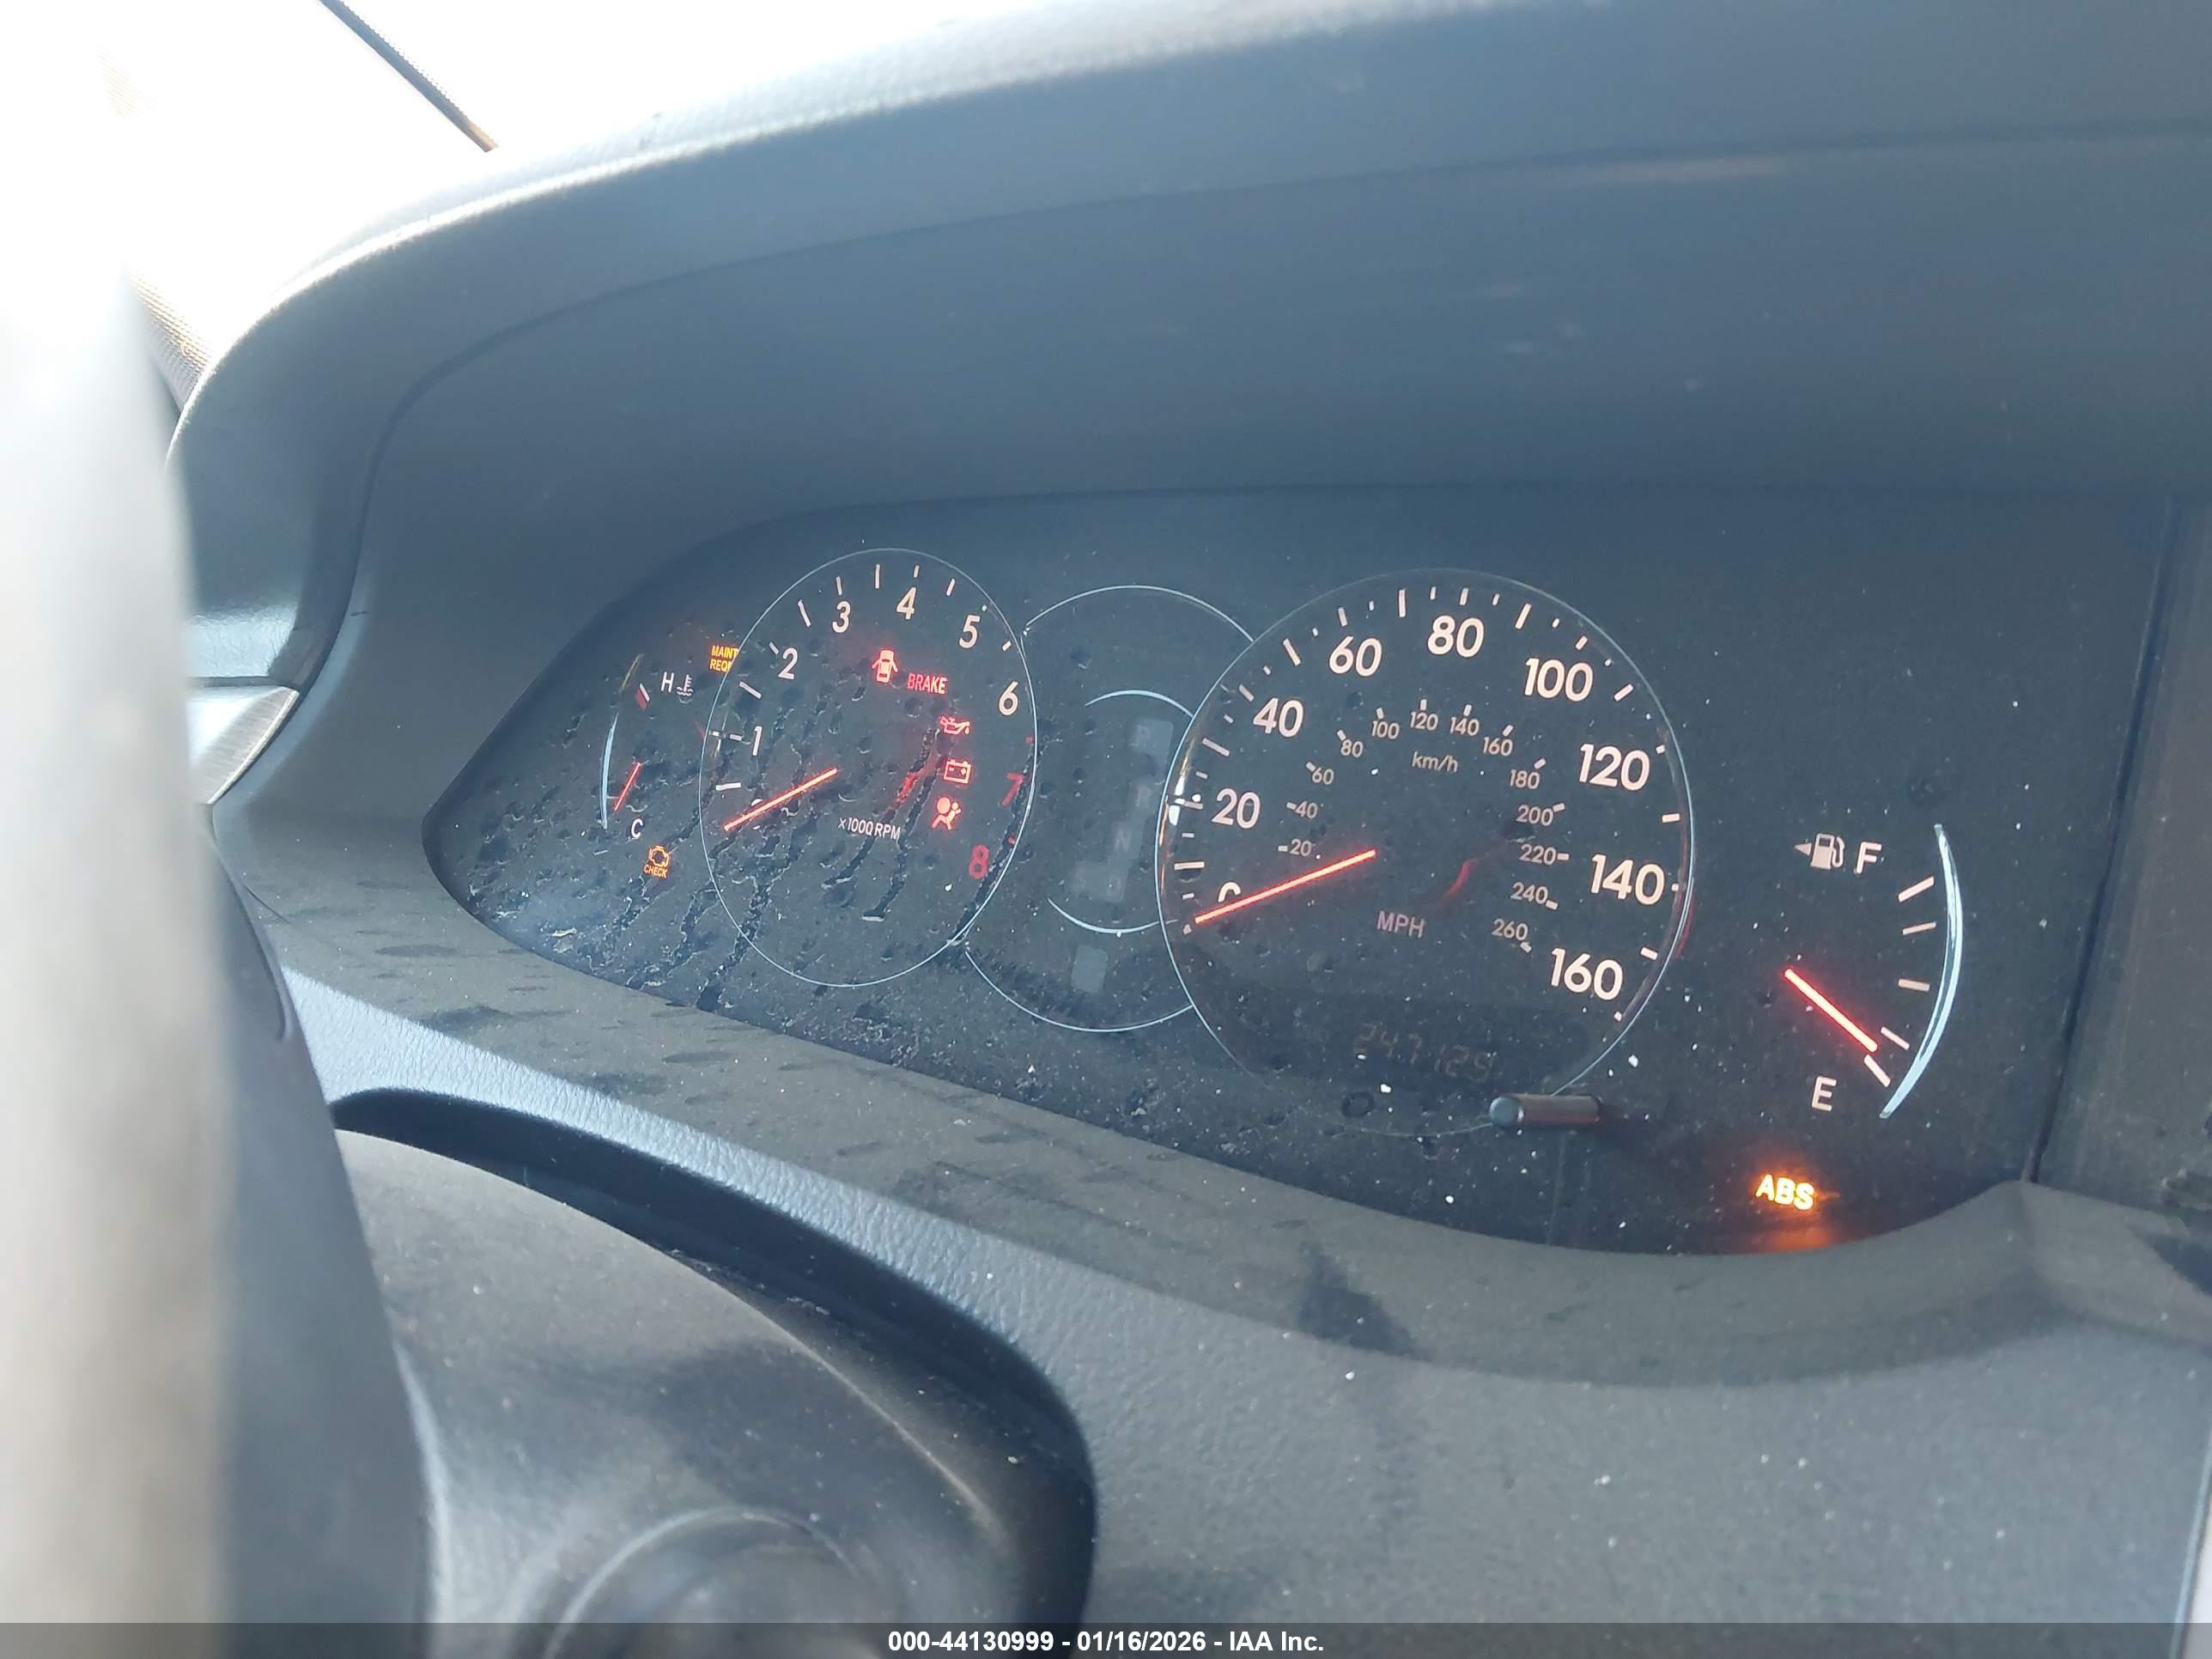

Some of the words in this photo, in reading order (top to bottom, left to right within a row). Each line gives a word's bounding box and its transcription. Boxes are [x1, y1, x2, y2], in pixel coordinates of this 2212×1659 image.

[832, 601, 851, 633] 3
[896, 587, 918, 619] 4
[959, 615, 981, 648] 5
[1427, 615, 1485, 658] 80
[711, 645, 739, 659] MAINT
[778, 647, 799, 679] 2
[1328, 635, 1383, 677] 60
[660, 672, 674, 693] H
[907, 672, 948, 696] BRAKE
[1523, 658, 1594, 702] 100
[998, 681, 1018, 715] 6
[1252, 697, 1304, 738] 40
[1371, 720, 1401, 740] 100
[1409, 711, 1439, 731] 120
[1449, 716, 1480, 736] 140
[751, 726, 763, 757] 1
[1340, 738, 1364, 757] 80
[1483, 736, 1513, 757] 160
[1311, 766, 1335, 786] 60
[1412, 751, 1458, 773] km/h
[1578, 743, 1650, 791] 120
[1001, 772, 1025, 806] 7
[1510, 769, 1540, 789] 180
[1212, 787, 1261, 830] 20
[1295, 799, 1319, 818] 40
[1515, 804, 1554, 826] 200
[631, 818, 643, 840] C
[968, 844, 990, 879] 8
[1290, 838, 1313, 857] 20
[1519, 843, 1558, 866] 220
[1856, 841, 1882, 874] F
[644, 864, 668, 878] CHECK
[1590, 854, 1665, 905] 140
[1510, 882, 1548, 904] 240
[1377, 910, 1425, 939] MPH
[1491, 918, 1528, 940] 260
[1550, 947, 1623, 1001] 160
[1811, 1076, 1837, 1111] E
[1755, 1173, 1816, 1211] ABS
